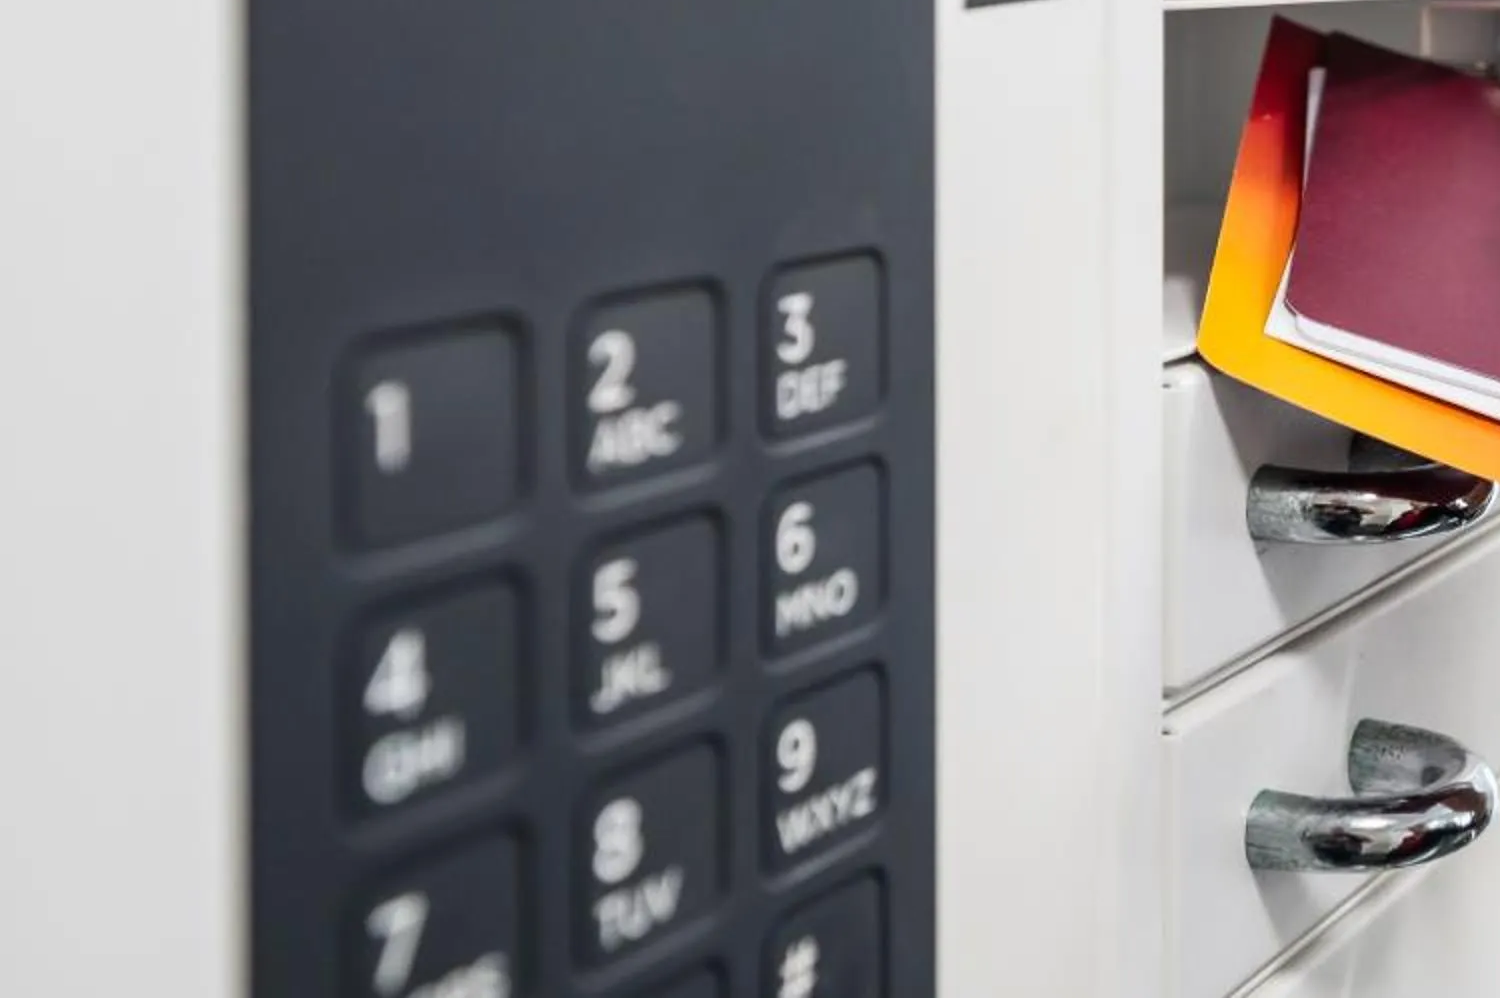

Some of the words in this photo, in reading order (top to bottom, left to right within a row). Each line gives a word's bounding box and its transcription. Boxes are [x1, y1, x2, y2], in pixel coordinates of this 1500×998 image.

[776, 291, 816, 364] 3
[587, 329, 637, 413] 2
[776, 359, 848, 420] DEF
[366, 381, 411, 471] 1
[588, 400, 682, 471] ABC
[776, 502, 816, 575] 6
[592, 558, 641, 643] 5
[776, 567, 858, 636] MNO
[364, 630, 429, 718] 4
[777, 720, 817, 793] 9
[592, 798, 643, 883] 8
[776, 767, 877, 853] WXYZ
[365, 891, 429, 997] 7
[593, 865, 684, 952] TUV
